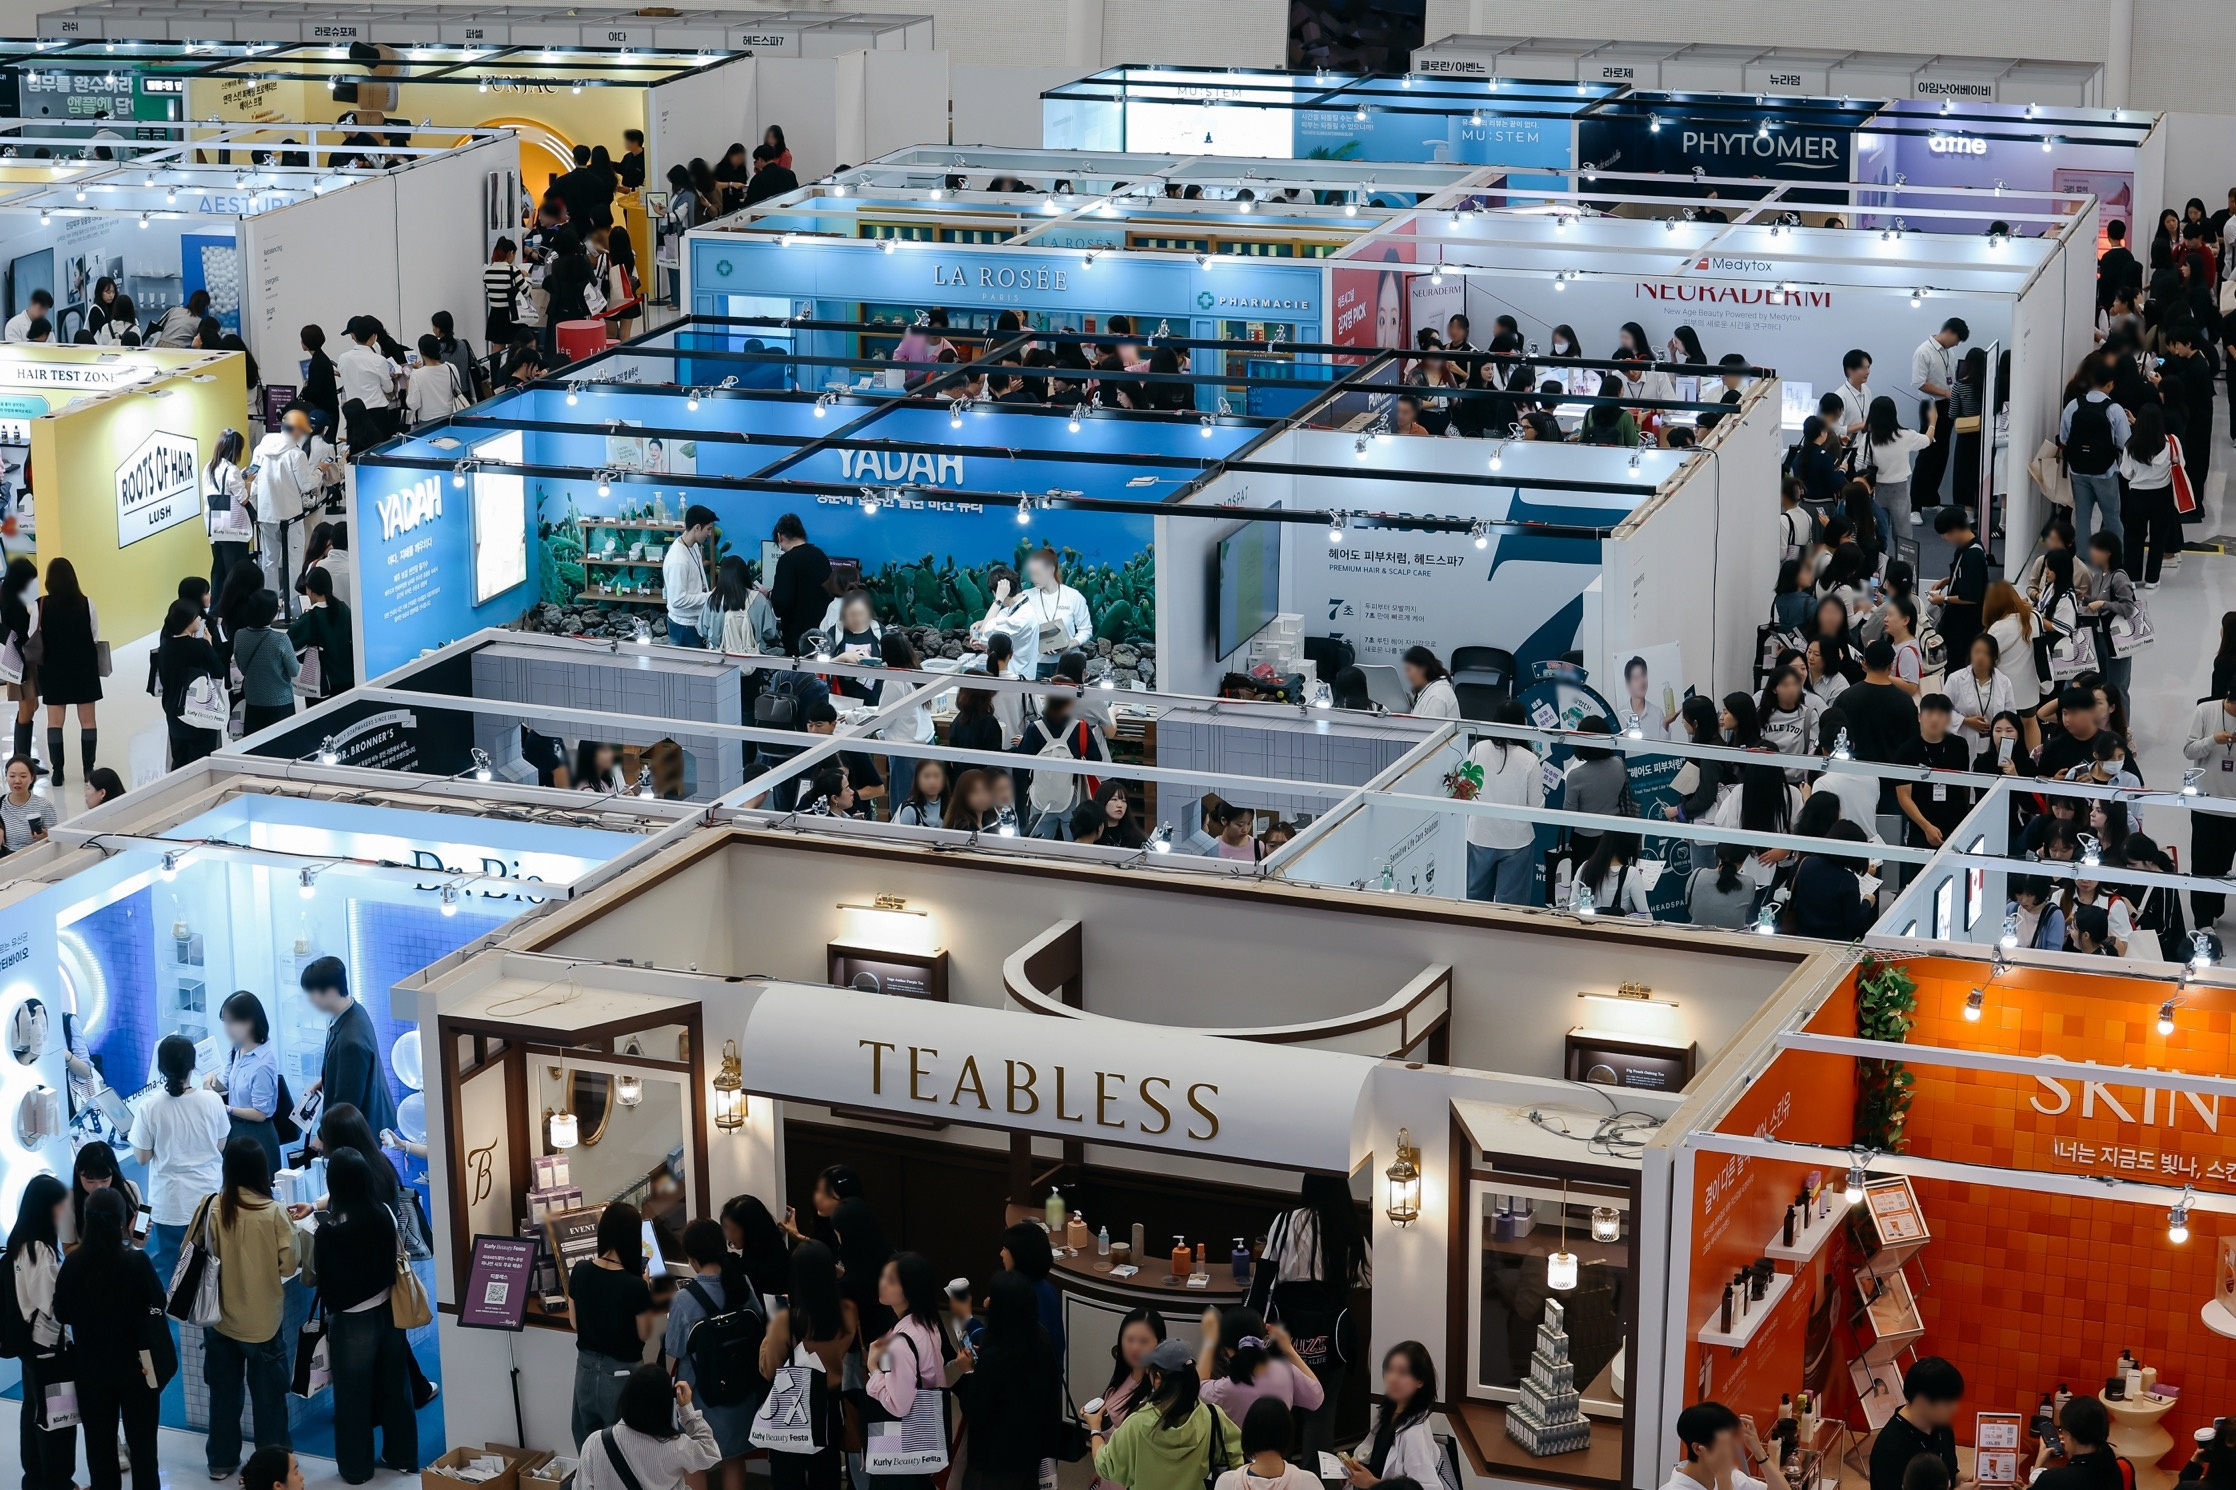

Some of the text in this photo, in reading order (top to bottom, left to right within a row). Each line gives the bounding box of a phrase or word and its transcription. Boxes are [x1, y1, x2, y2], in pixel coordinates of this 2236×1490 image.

[314, 26, 357, 37] 라로슈포제
[466, 29, 484, 40] 퍼셀
[608, 32, 627, 42] 야다
[742, 36, 784, 46] 헤드스파7
[1420, 60, 1486, 73] 클로란/아벤느
[1603, 68, 1634, 78] 라로제
[1769, 74, 1800, 86] 뉴라덤
[1918, 82, 1992, 97] 아임낫어베이비
[1462, 130, 1540, 142] MU:STEM
[1682, 131, 1840, 160] PHYTOMER
[1712, 258, 1772, 272] Medytox
[933, 265, 1068, 291] LA ROSÉE
[982, 292, 1020, 302] PARIS
[1412, 285, 1462, 298] NEURADERM
[1218, 296, 1310, 310] PHARMACIE
[1664, 307, 1802, 322] New Age Beauty Powered by Medytox
[17, 368, 117, 383] HAIR TEST ZONE
[836, 449, 964, 485] YADAH
[122, 445, 194, 507] ROOTS OF HAIR
[148, 505, 172, 524] LUSH
[376, 474, 442, 541] YADAH
[1328, 548, 1464, 566] 헤어도 피부처럼, 헤드스파7
[1329, 564, 1362, 574] PREMIUM
[1364, 566, 1380, 574] HAIR
[1388, 567, 1411, 576] SCALP
[1413, 568, 1432, 577] CARE
[350, 728, 394, 756] BRONNER'S
[1390, 820, 1438, 864] Sensitive Life Care Solution
[0, 947, 29, 972] 터바이오
[859, 1040, 1219, 1140] TEABLESS
[2030, 1055, 2220, 1133] SKIN
[2060, 1142, 2202, 1180] 너는 지금도 빛나,
[570, 1224, 596, 1234] EVENT
[752, 1432, 766, 1440] Kurly
[766, 1434, 789, 1443] Beauty
[873, 1455, 942, 1468] Kurly Beauty Festa
